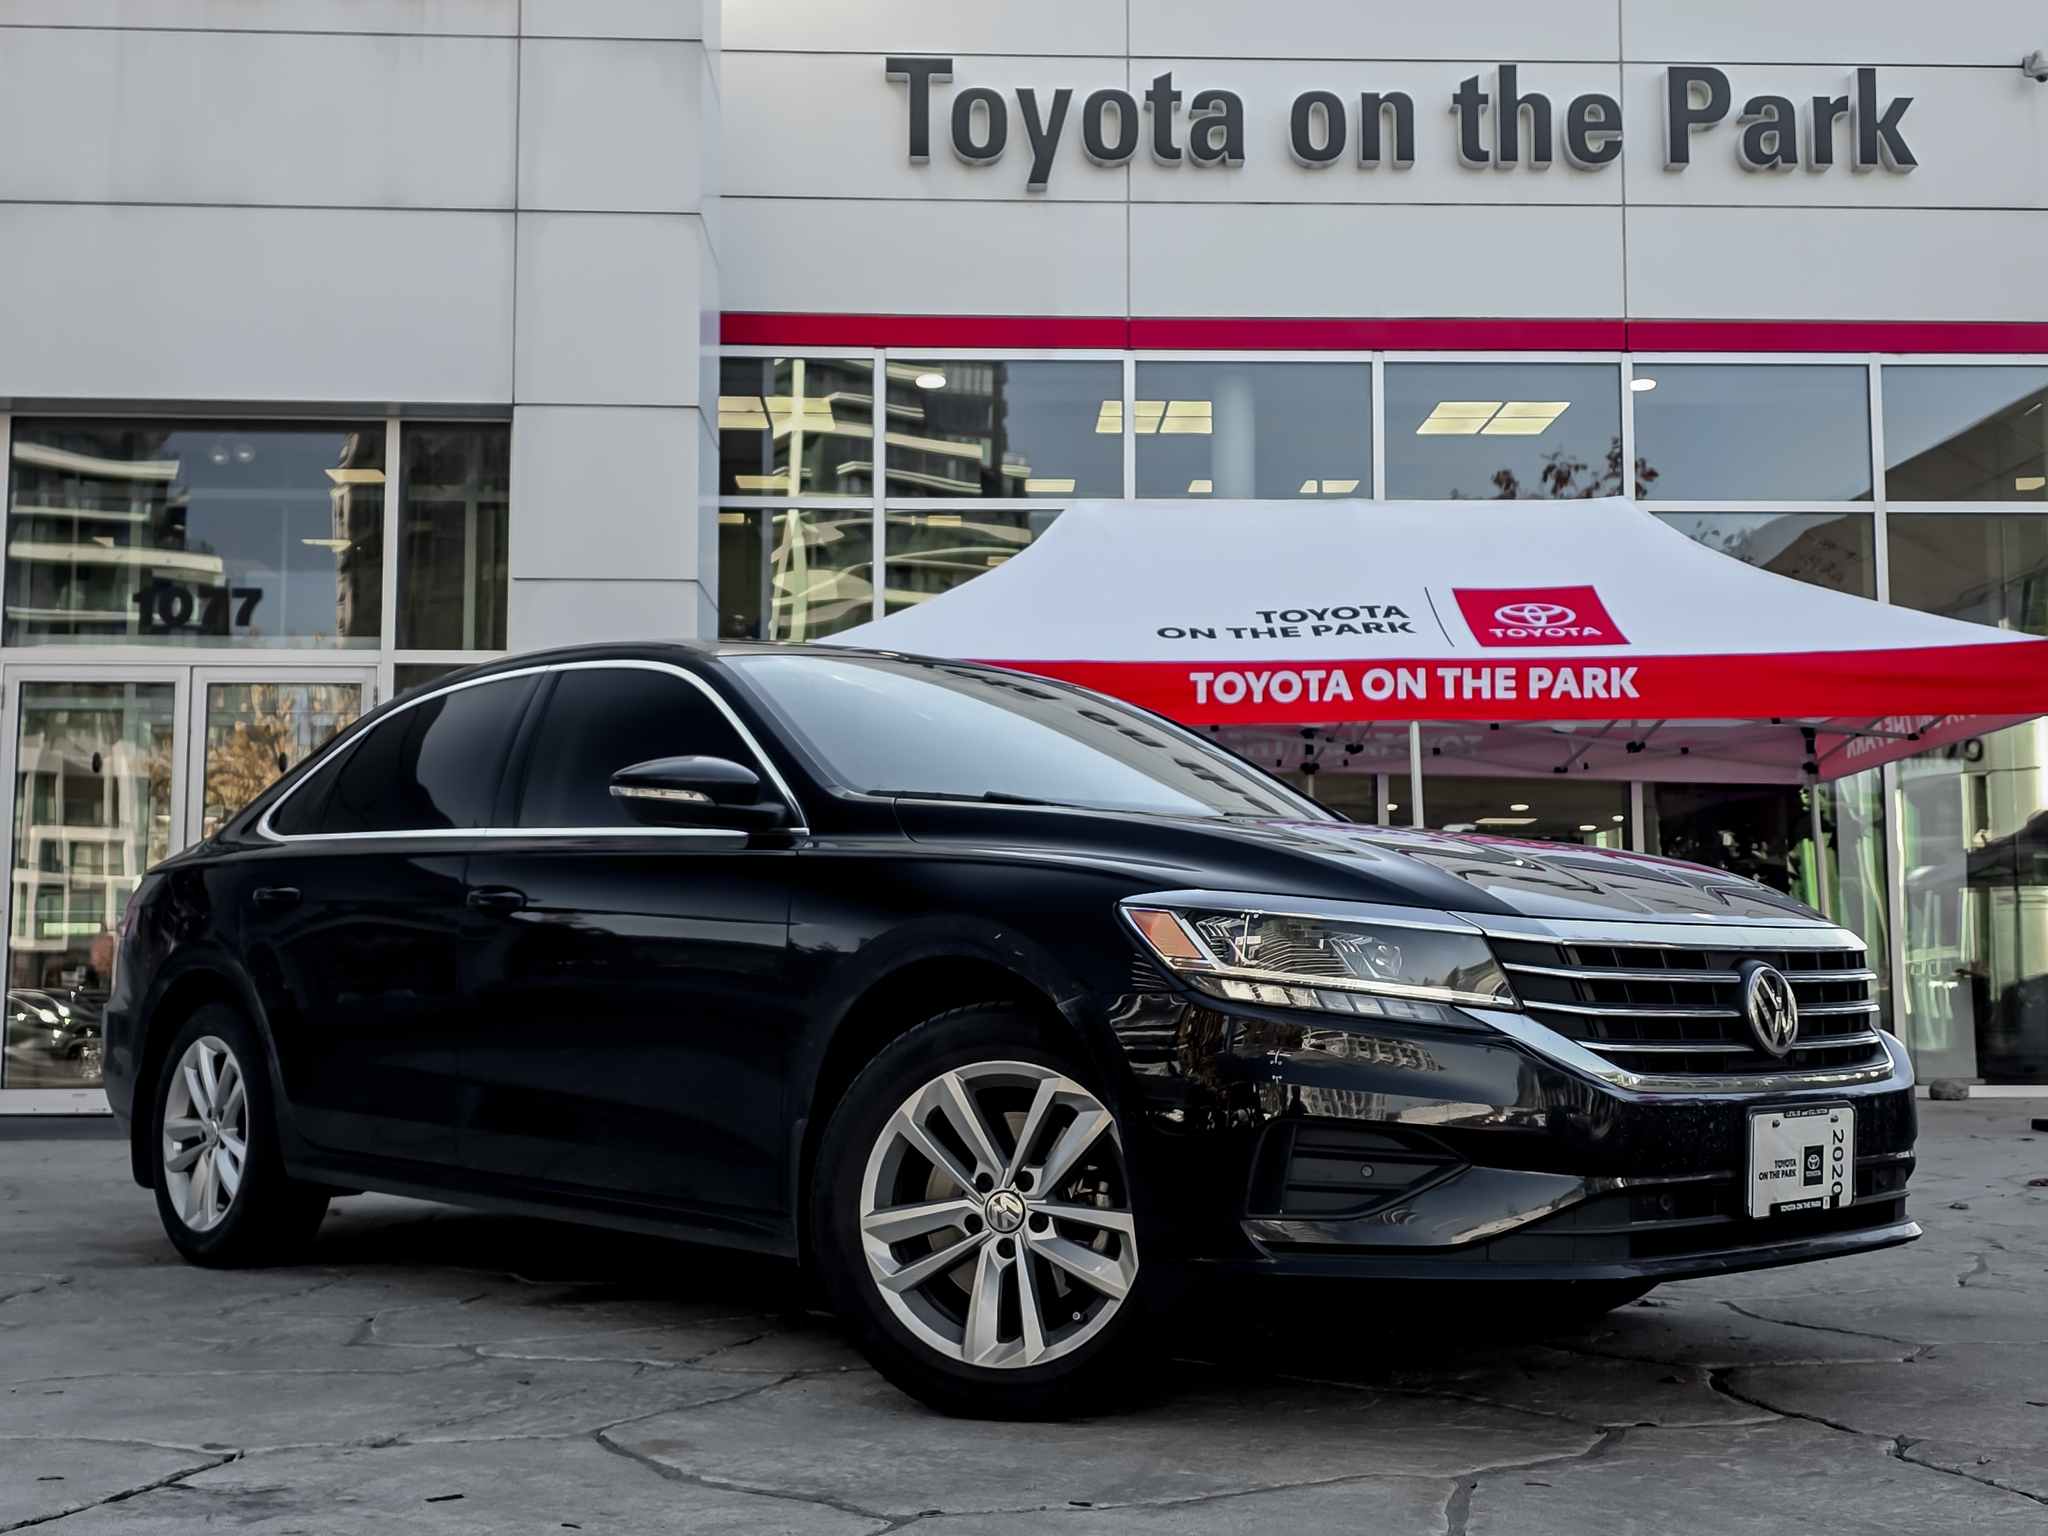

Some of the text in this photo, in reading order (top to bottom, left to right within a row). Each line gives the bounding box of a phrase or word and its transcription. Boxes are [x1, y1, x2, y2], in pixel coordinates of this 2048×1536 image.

[886, 57, 1918, 191] Toyota on the Park
[132, 587, 263, 626] 1077
[1256, 605, 1410, 624] TOYOTA
[1157, 621, 1417, 639] ON THE PARK
[1488, 627, 1603, 639] TOYOTA
[1190, 666, 1640, 704] TOYOTA ON THE PARK
[1774, 1159, 1797, 1168] TOYOTA
[1832, 1129, 1844, 1196] 2020
[1759, 1171, 1769, 1180] ON
[1769, 1170, 1780, 1179] THE
[1781, 1169, 1797, 1178] PARK
